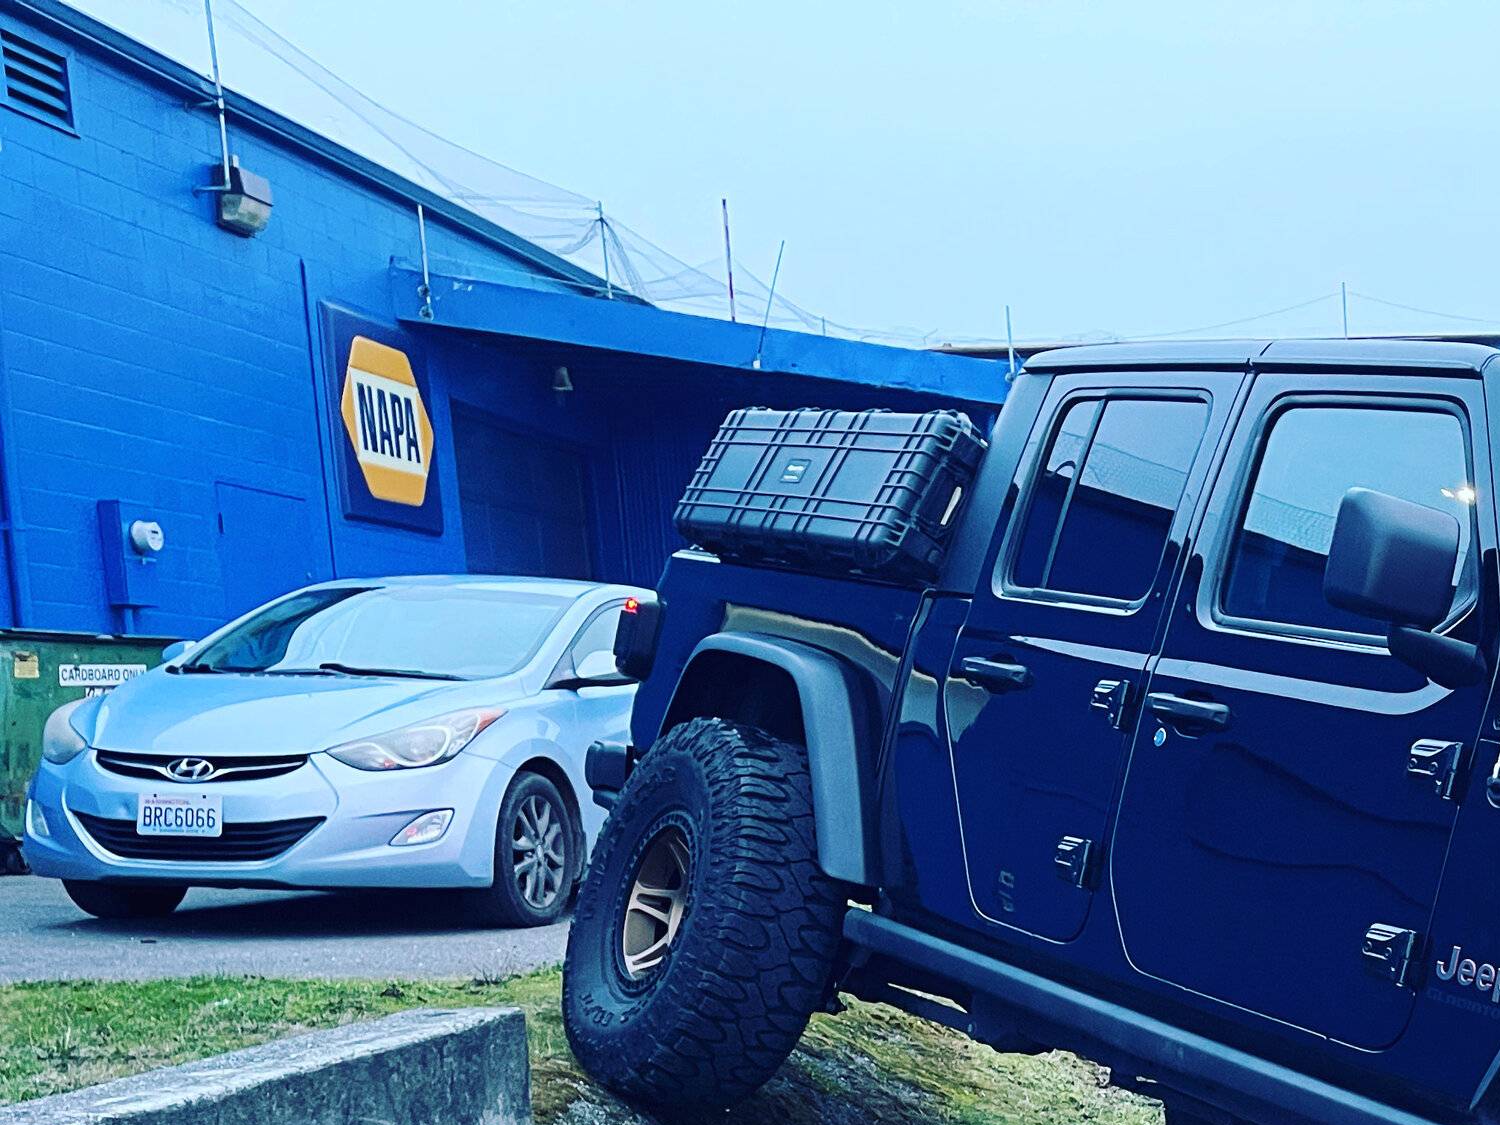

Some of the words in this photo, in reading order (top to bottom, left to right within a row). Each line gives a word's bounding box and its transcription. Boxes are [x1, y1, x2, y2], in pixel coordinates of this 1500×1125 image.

[356, 382, 421, 464] NAPA
[61, 668, 120, 681] CARDBOARD
[143, 806, 216, 828] BRC6066
